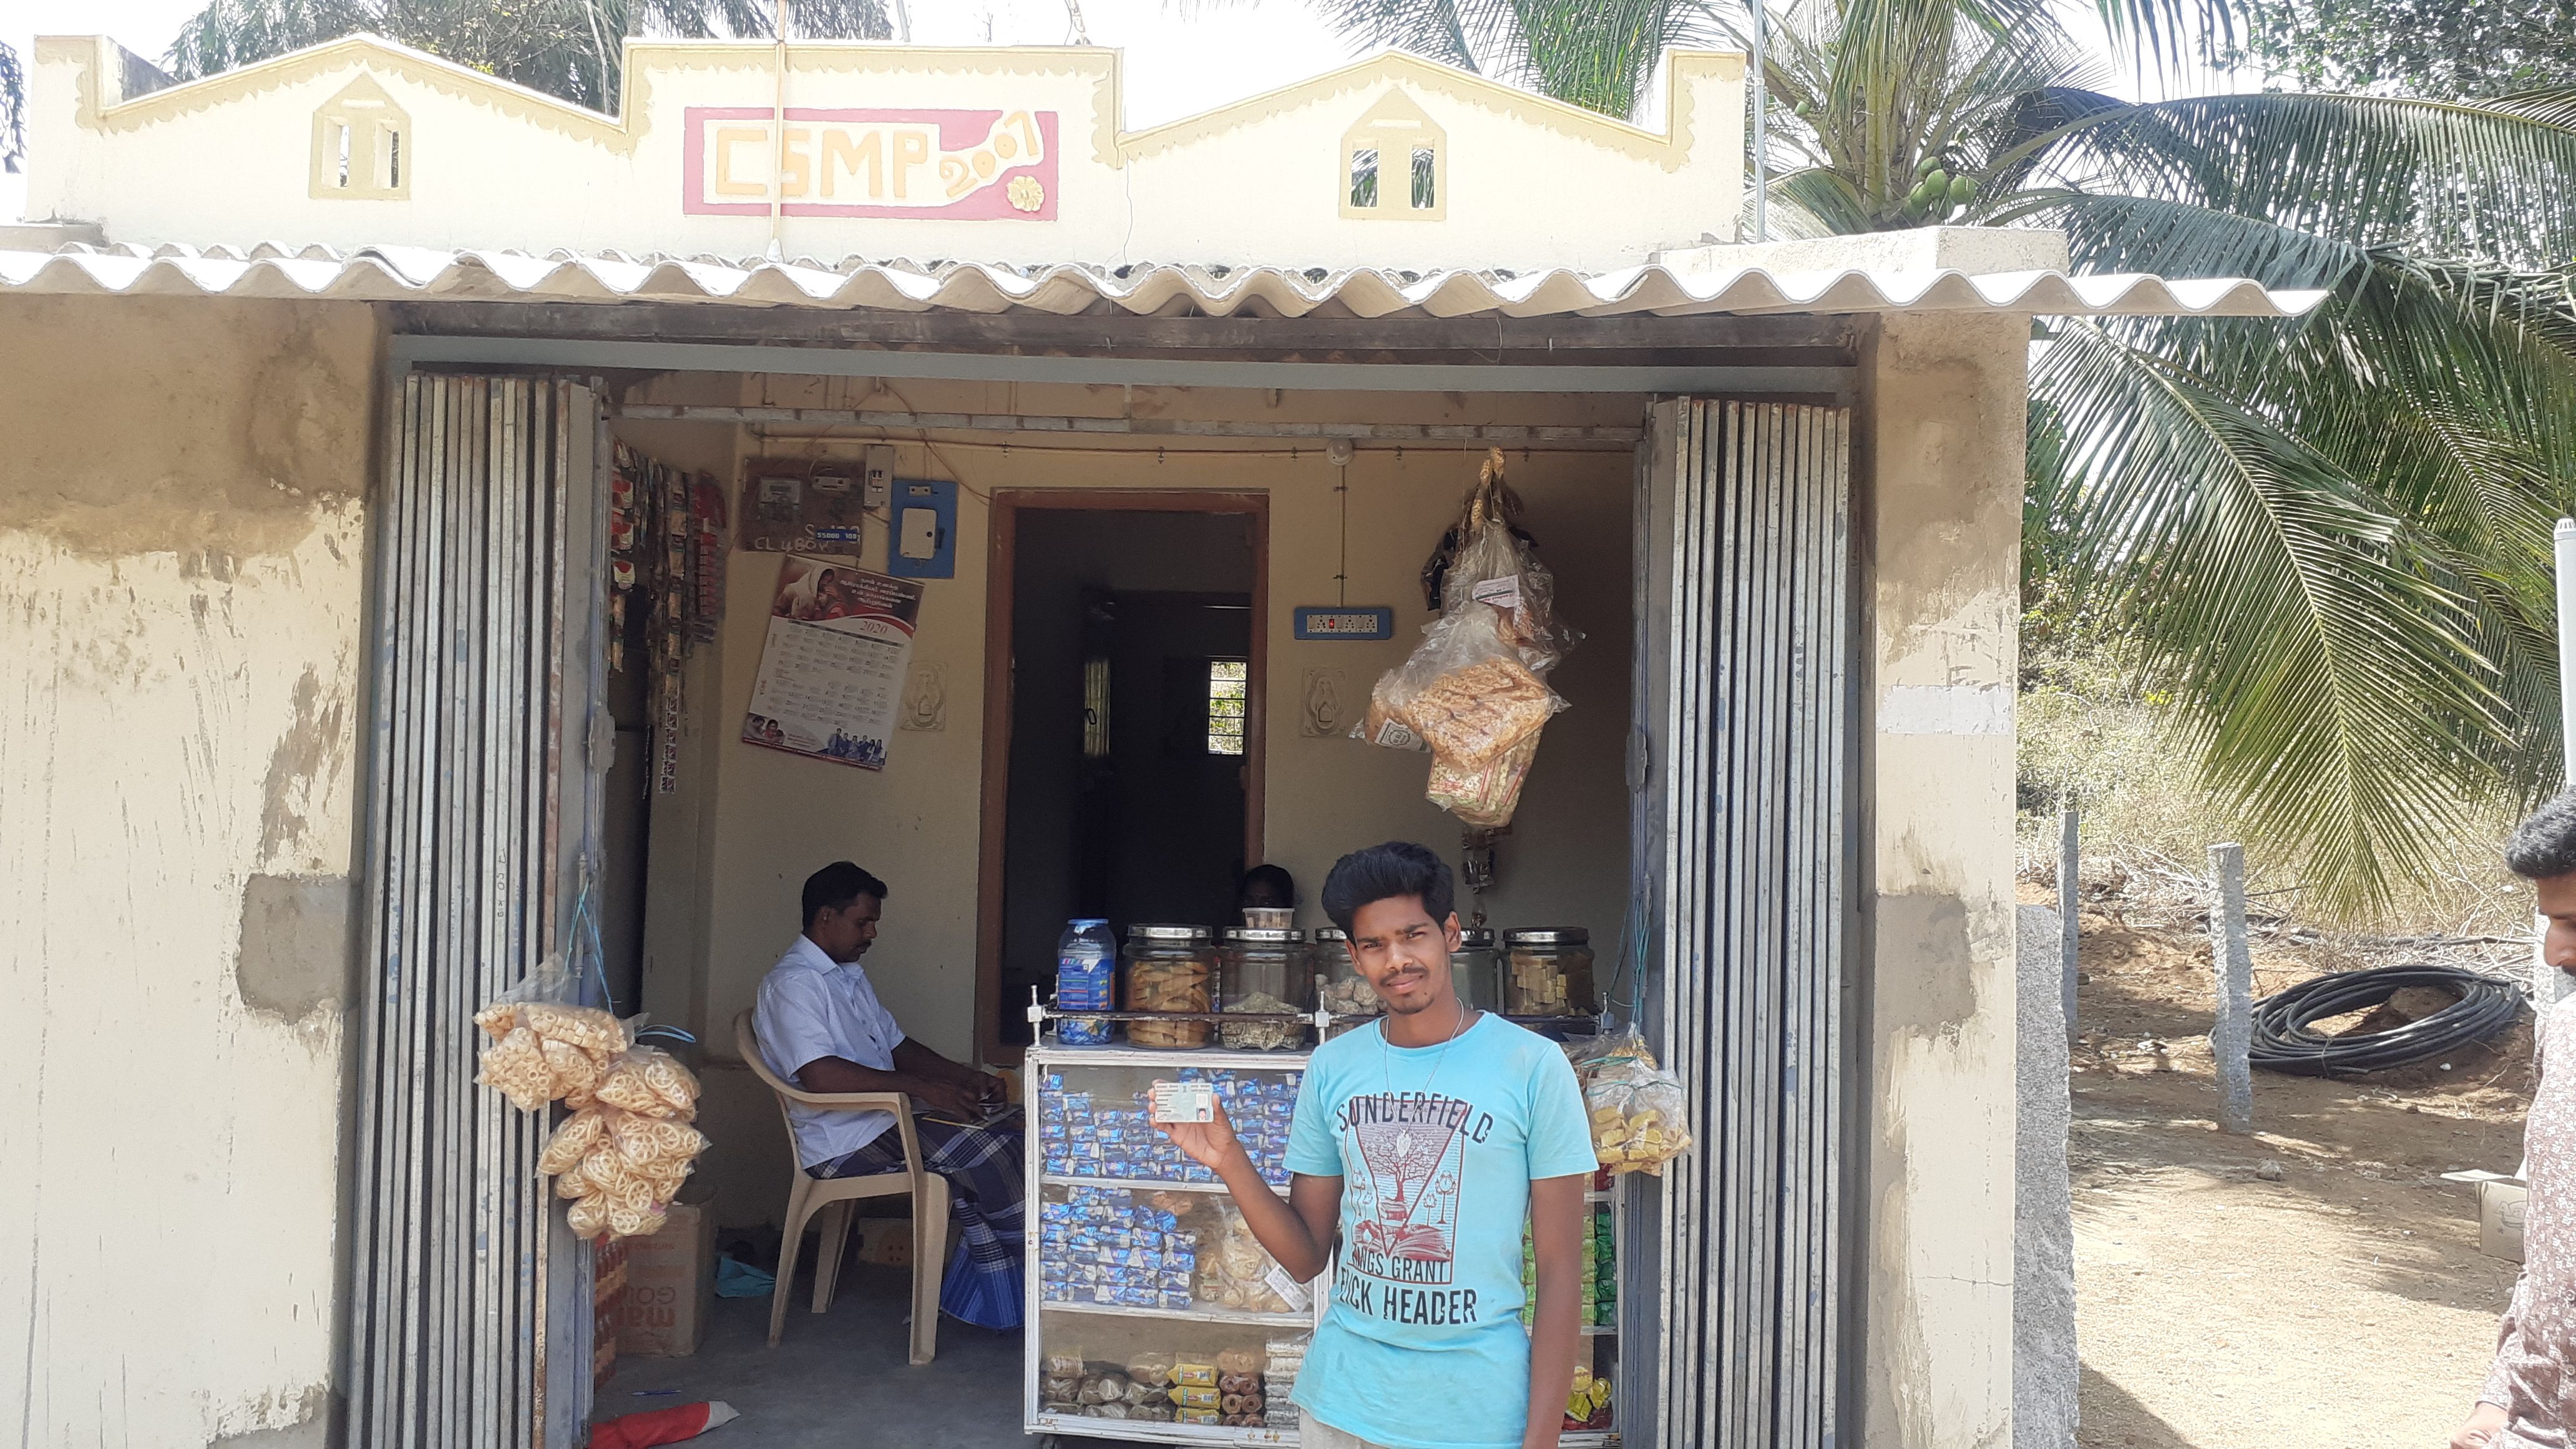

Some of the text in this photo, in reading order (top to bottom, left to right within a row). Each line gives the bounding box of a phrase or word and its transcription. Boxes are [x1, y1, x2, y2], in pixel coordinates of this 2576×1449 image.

[859, 621, 889, 635] 2020
[1336, 1091, 1493, 1144] SUNDERFIELD
[1392, 1255, 1447, 1283] GRANT
[1383, 1284, 1477, 1325] HEADER
